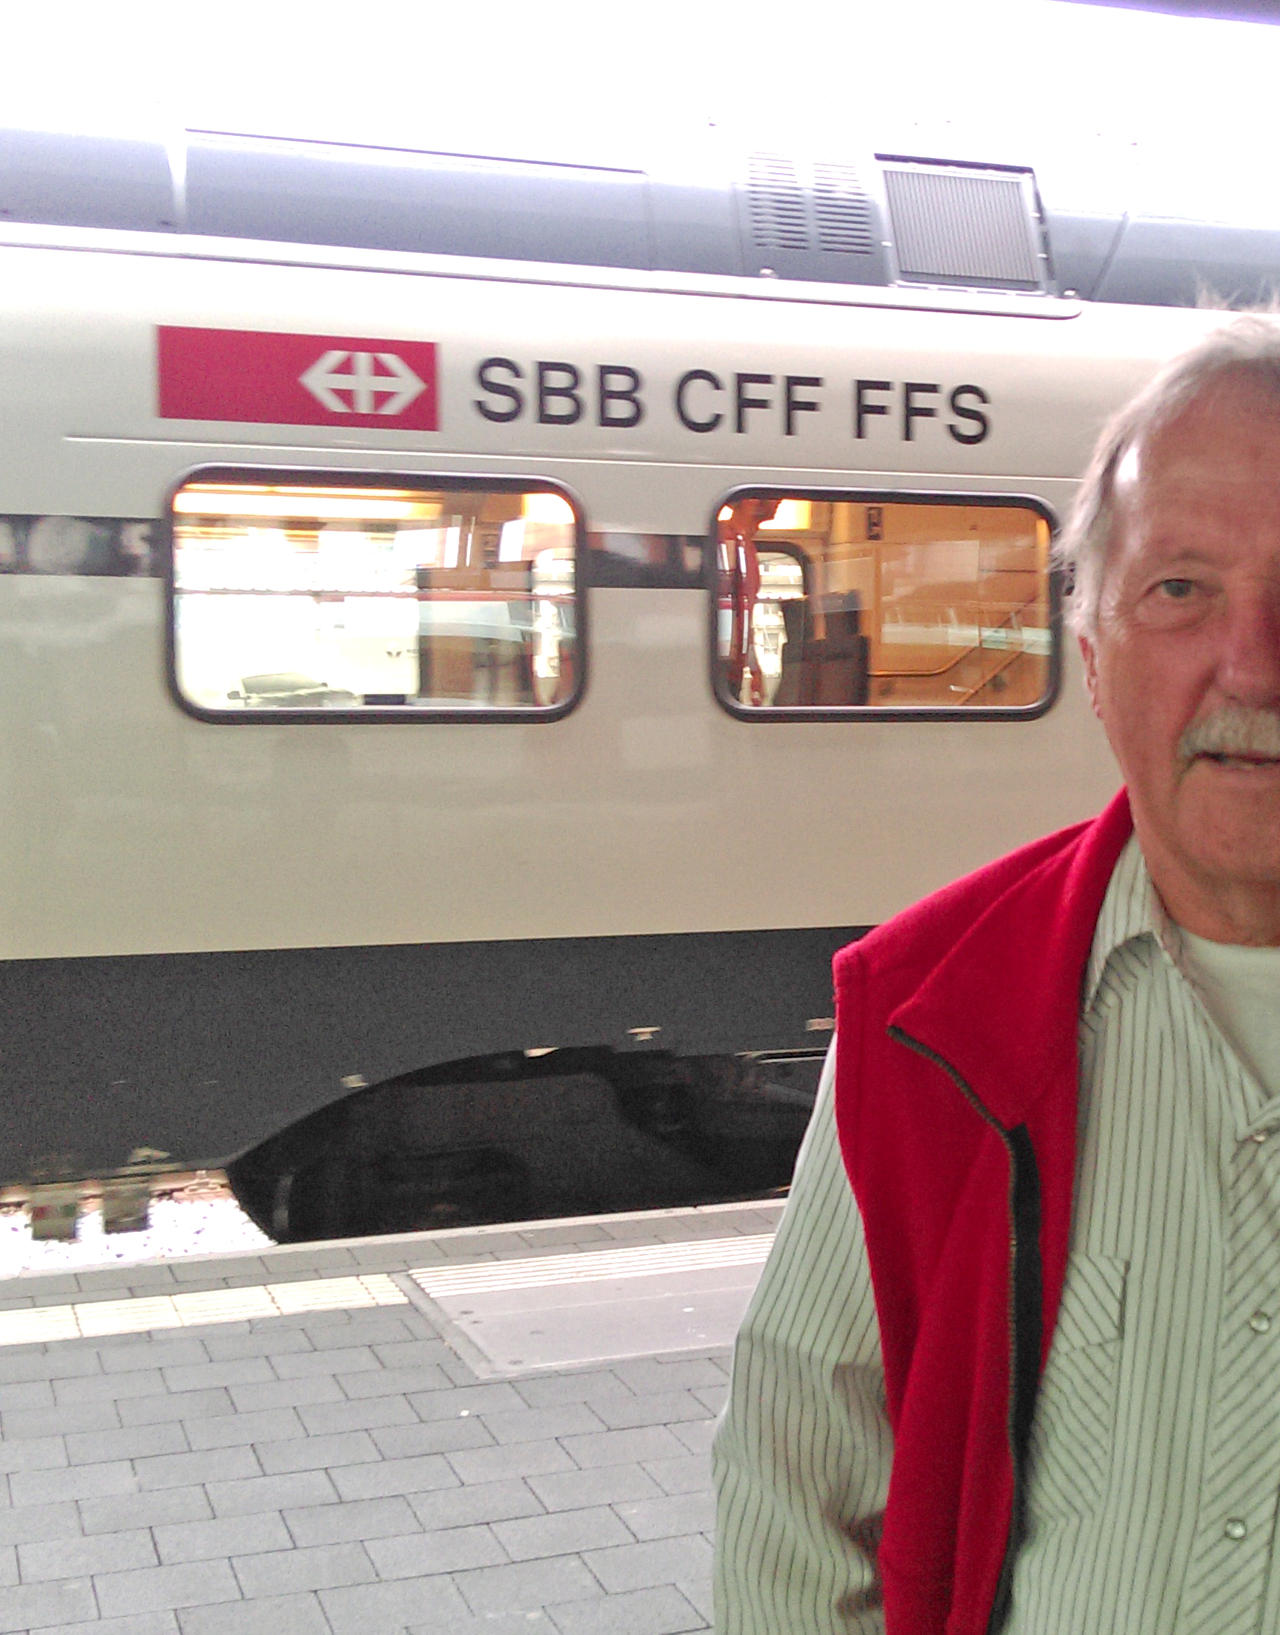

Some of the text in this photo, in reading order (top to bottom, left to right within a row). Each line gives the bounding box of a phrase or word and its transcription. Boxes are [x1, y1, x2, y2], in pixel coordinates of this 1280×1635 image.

[474, 356, 990, 447] SBB CFF FFS
